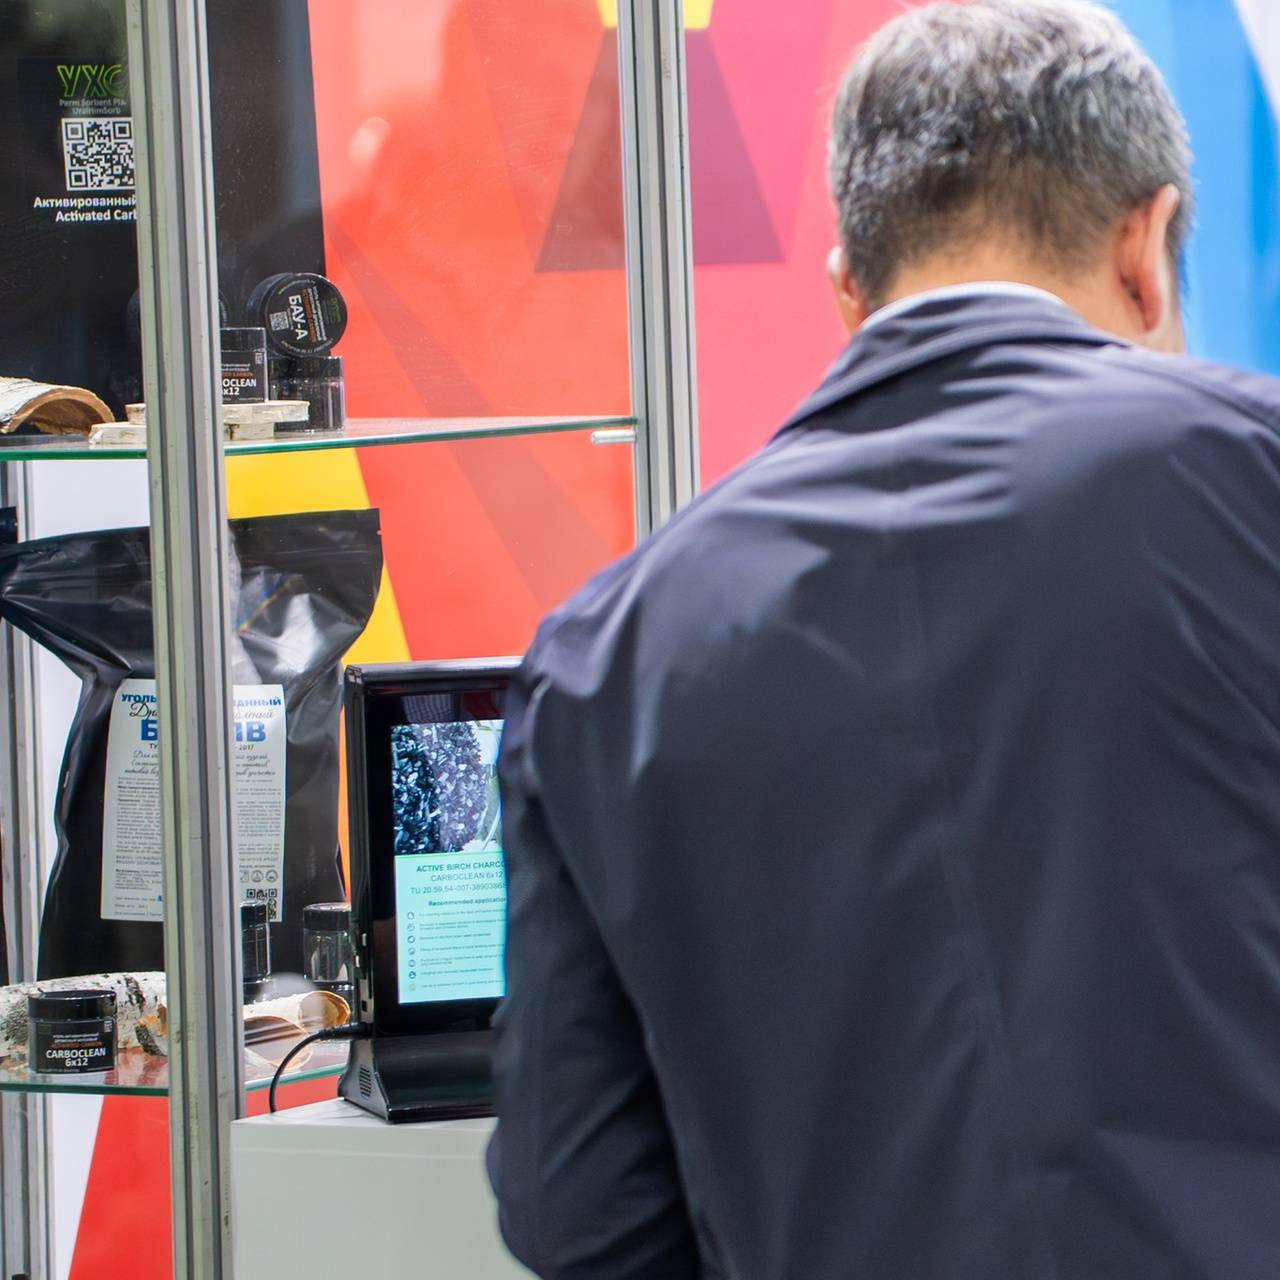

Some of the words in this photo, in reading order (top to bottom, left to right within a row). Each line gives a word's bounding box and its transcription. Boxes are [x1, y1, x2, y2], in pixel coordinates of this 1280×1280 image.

[59, 99, 80, 107] Perm
[81, 98, 112, 107] Sorbent
[56, 210, 110, 222] Activated
[288, 294, 309, 341] БАУ-А
[222, 378, 257, 388] OCLEAN
[222, 387, 240, 396] x12
[121, 693, 157, 703] УГОЛЬ
[416, 864, 445, 873] ACTIVE
[446, 862, 471, 871] BIRCH
[430, 871, 485, 882] CARBOCLEAN
[485, 871, 504, 879] 6x12
[411, 887, 421, 895] TU
[428, 898, 474, 907] Recommended
[46, 1048, 106, 1058] CARBOCLEAN
[65, 1058, 88, 1067] 6x12
